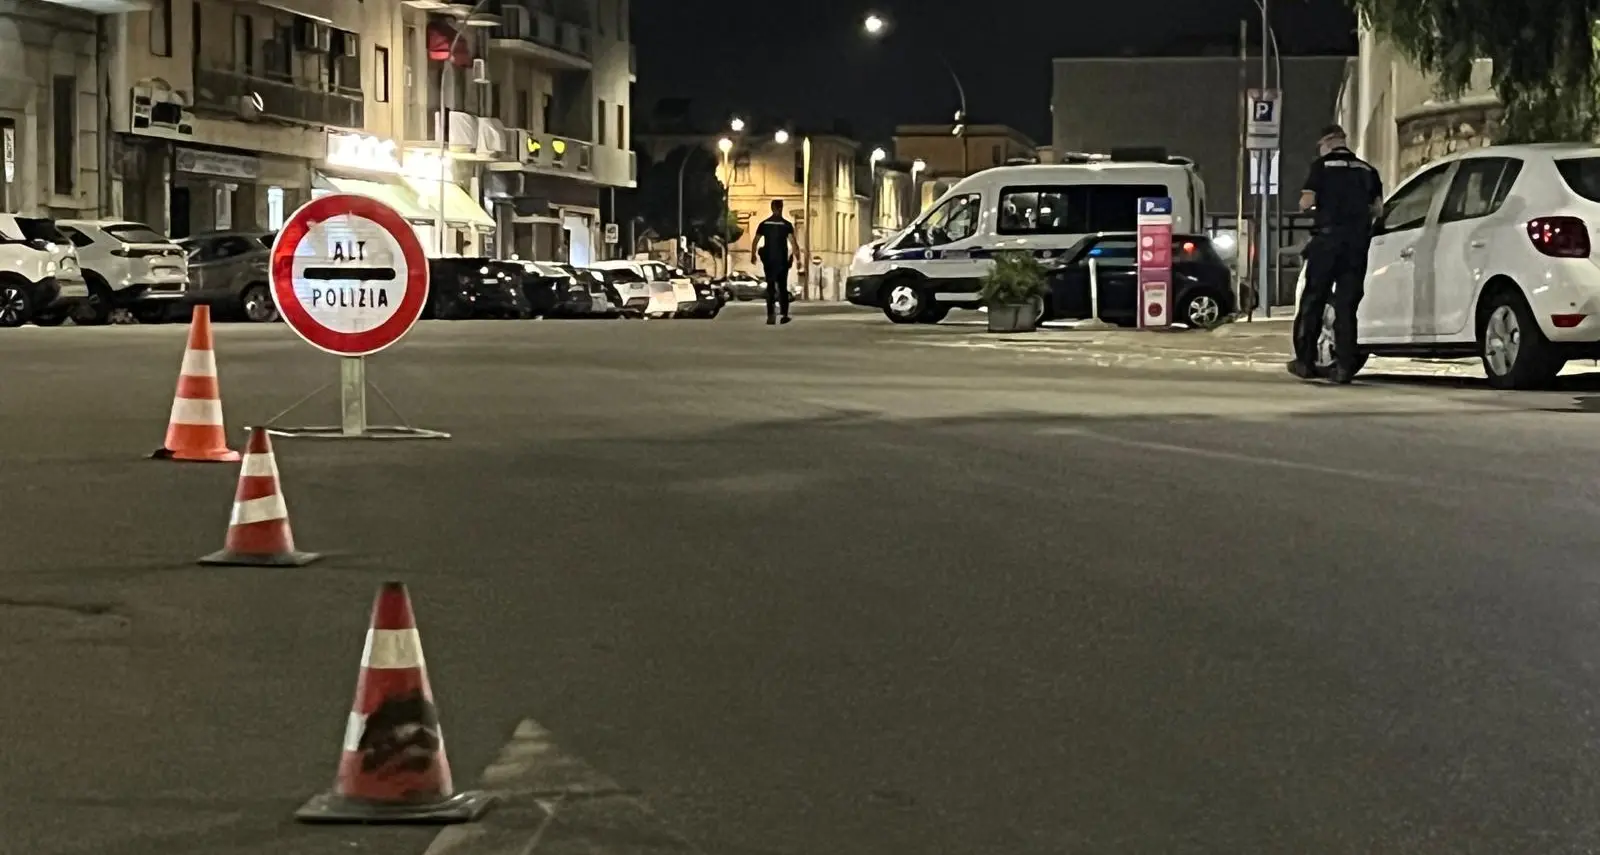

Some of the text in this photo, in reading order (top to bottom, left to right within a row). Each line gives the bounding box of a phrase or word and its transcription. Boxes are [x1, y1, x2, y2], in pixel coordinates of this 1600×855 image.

[1255, 103, 1269, 119] P
[333, 241, 366, 261] ALT
[312, 288, 388, 308] POLIZIA
